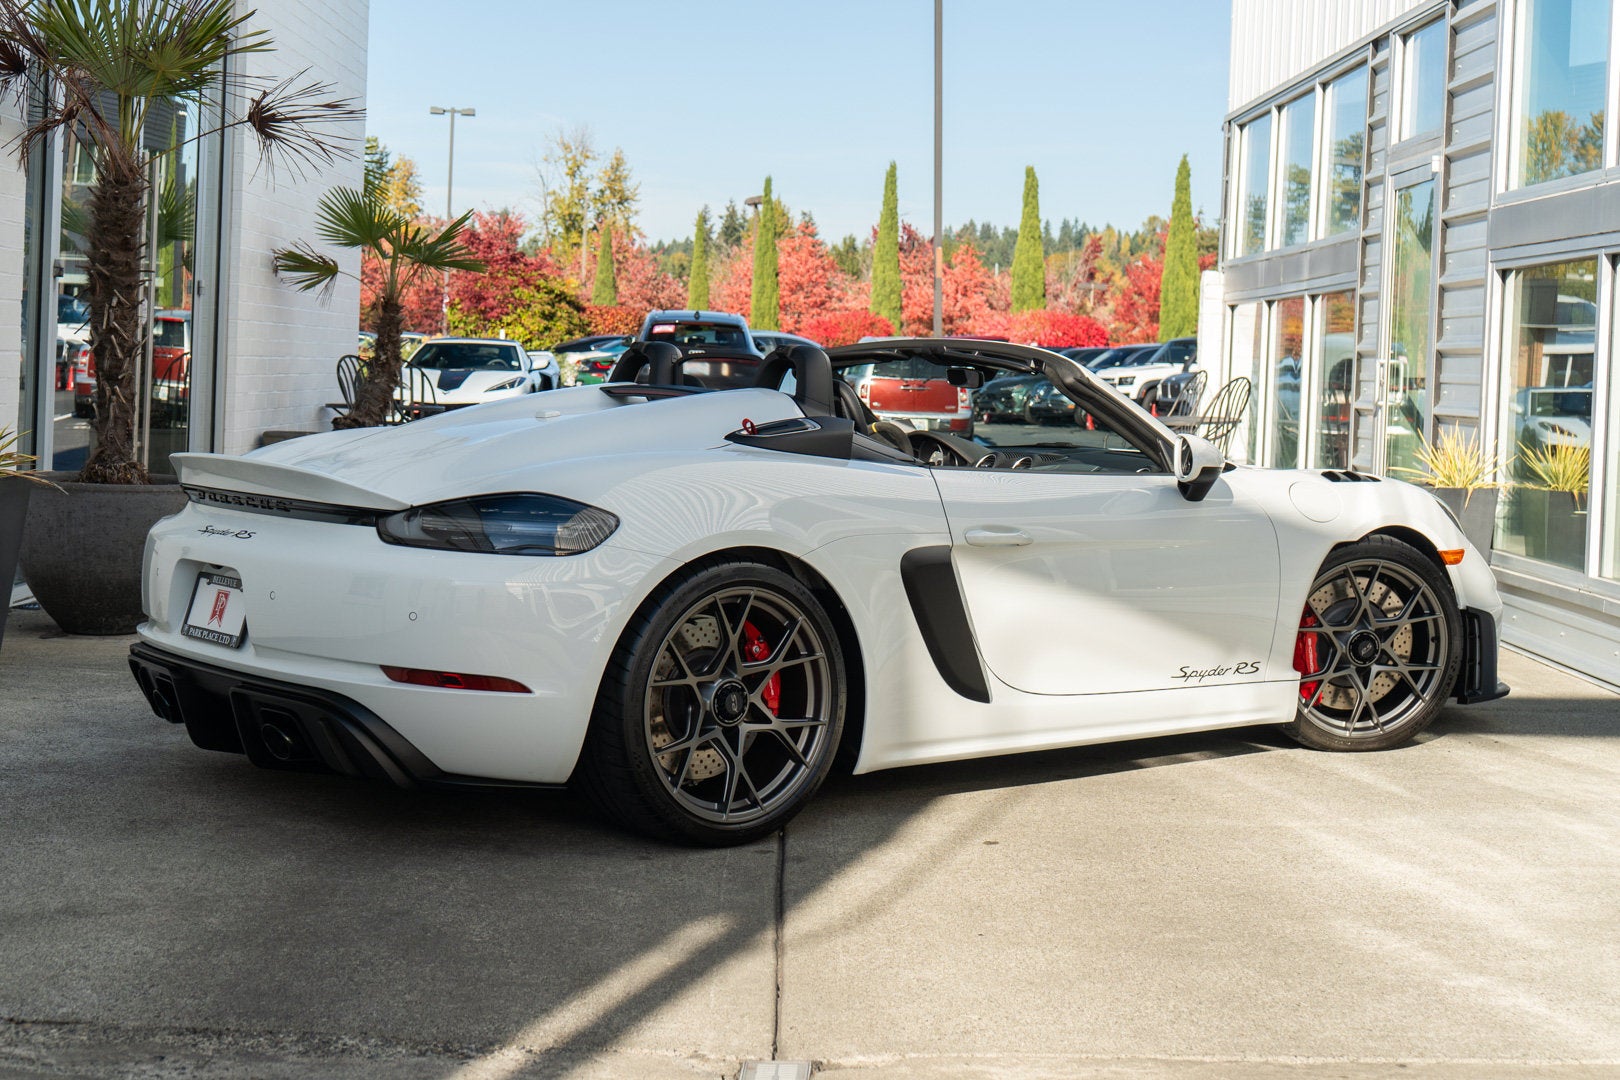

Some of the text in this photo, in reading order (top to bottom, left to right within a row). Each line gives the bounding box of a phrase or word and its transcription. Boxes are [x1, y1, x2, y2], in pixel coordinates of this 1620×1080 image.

[232, 529, 257, 539] RS
[188, 627, 231, 645] PARK PLACE LTD
[1170, 661, 1261, 683] Spyder RS
